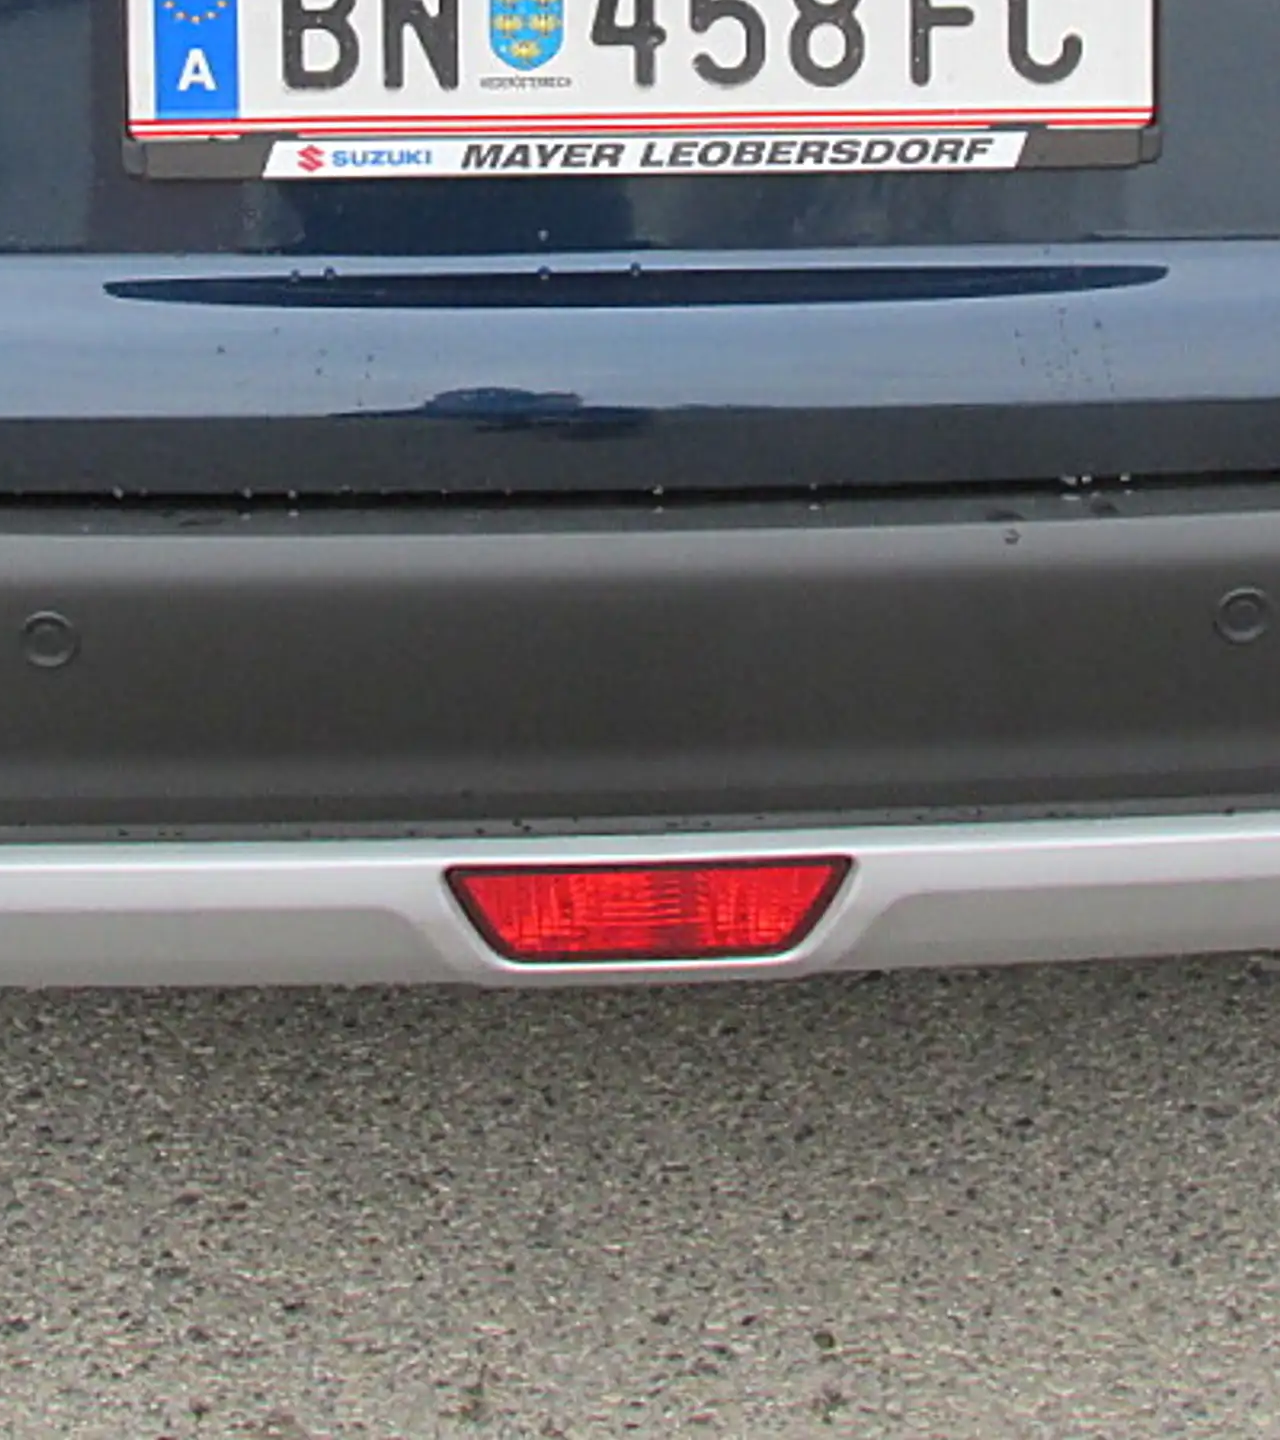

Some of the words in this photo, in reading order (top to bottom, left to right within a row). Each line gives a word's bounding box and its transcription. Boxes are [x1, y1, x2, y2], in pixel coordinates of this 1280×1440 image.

[177, 48, 217, 91] A
[331, 150, 433, 168] SUZUKI
[459, 140, 627, 170] MAYER
[638, 136, 994, 167] LEOBERSDORF
